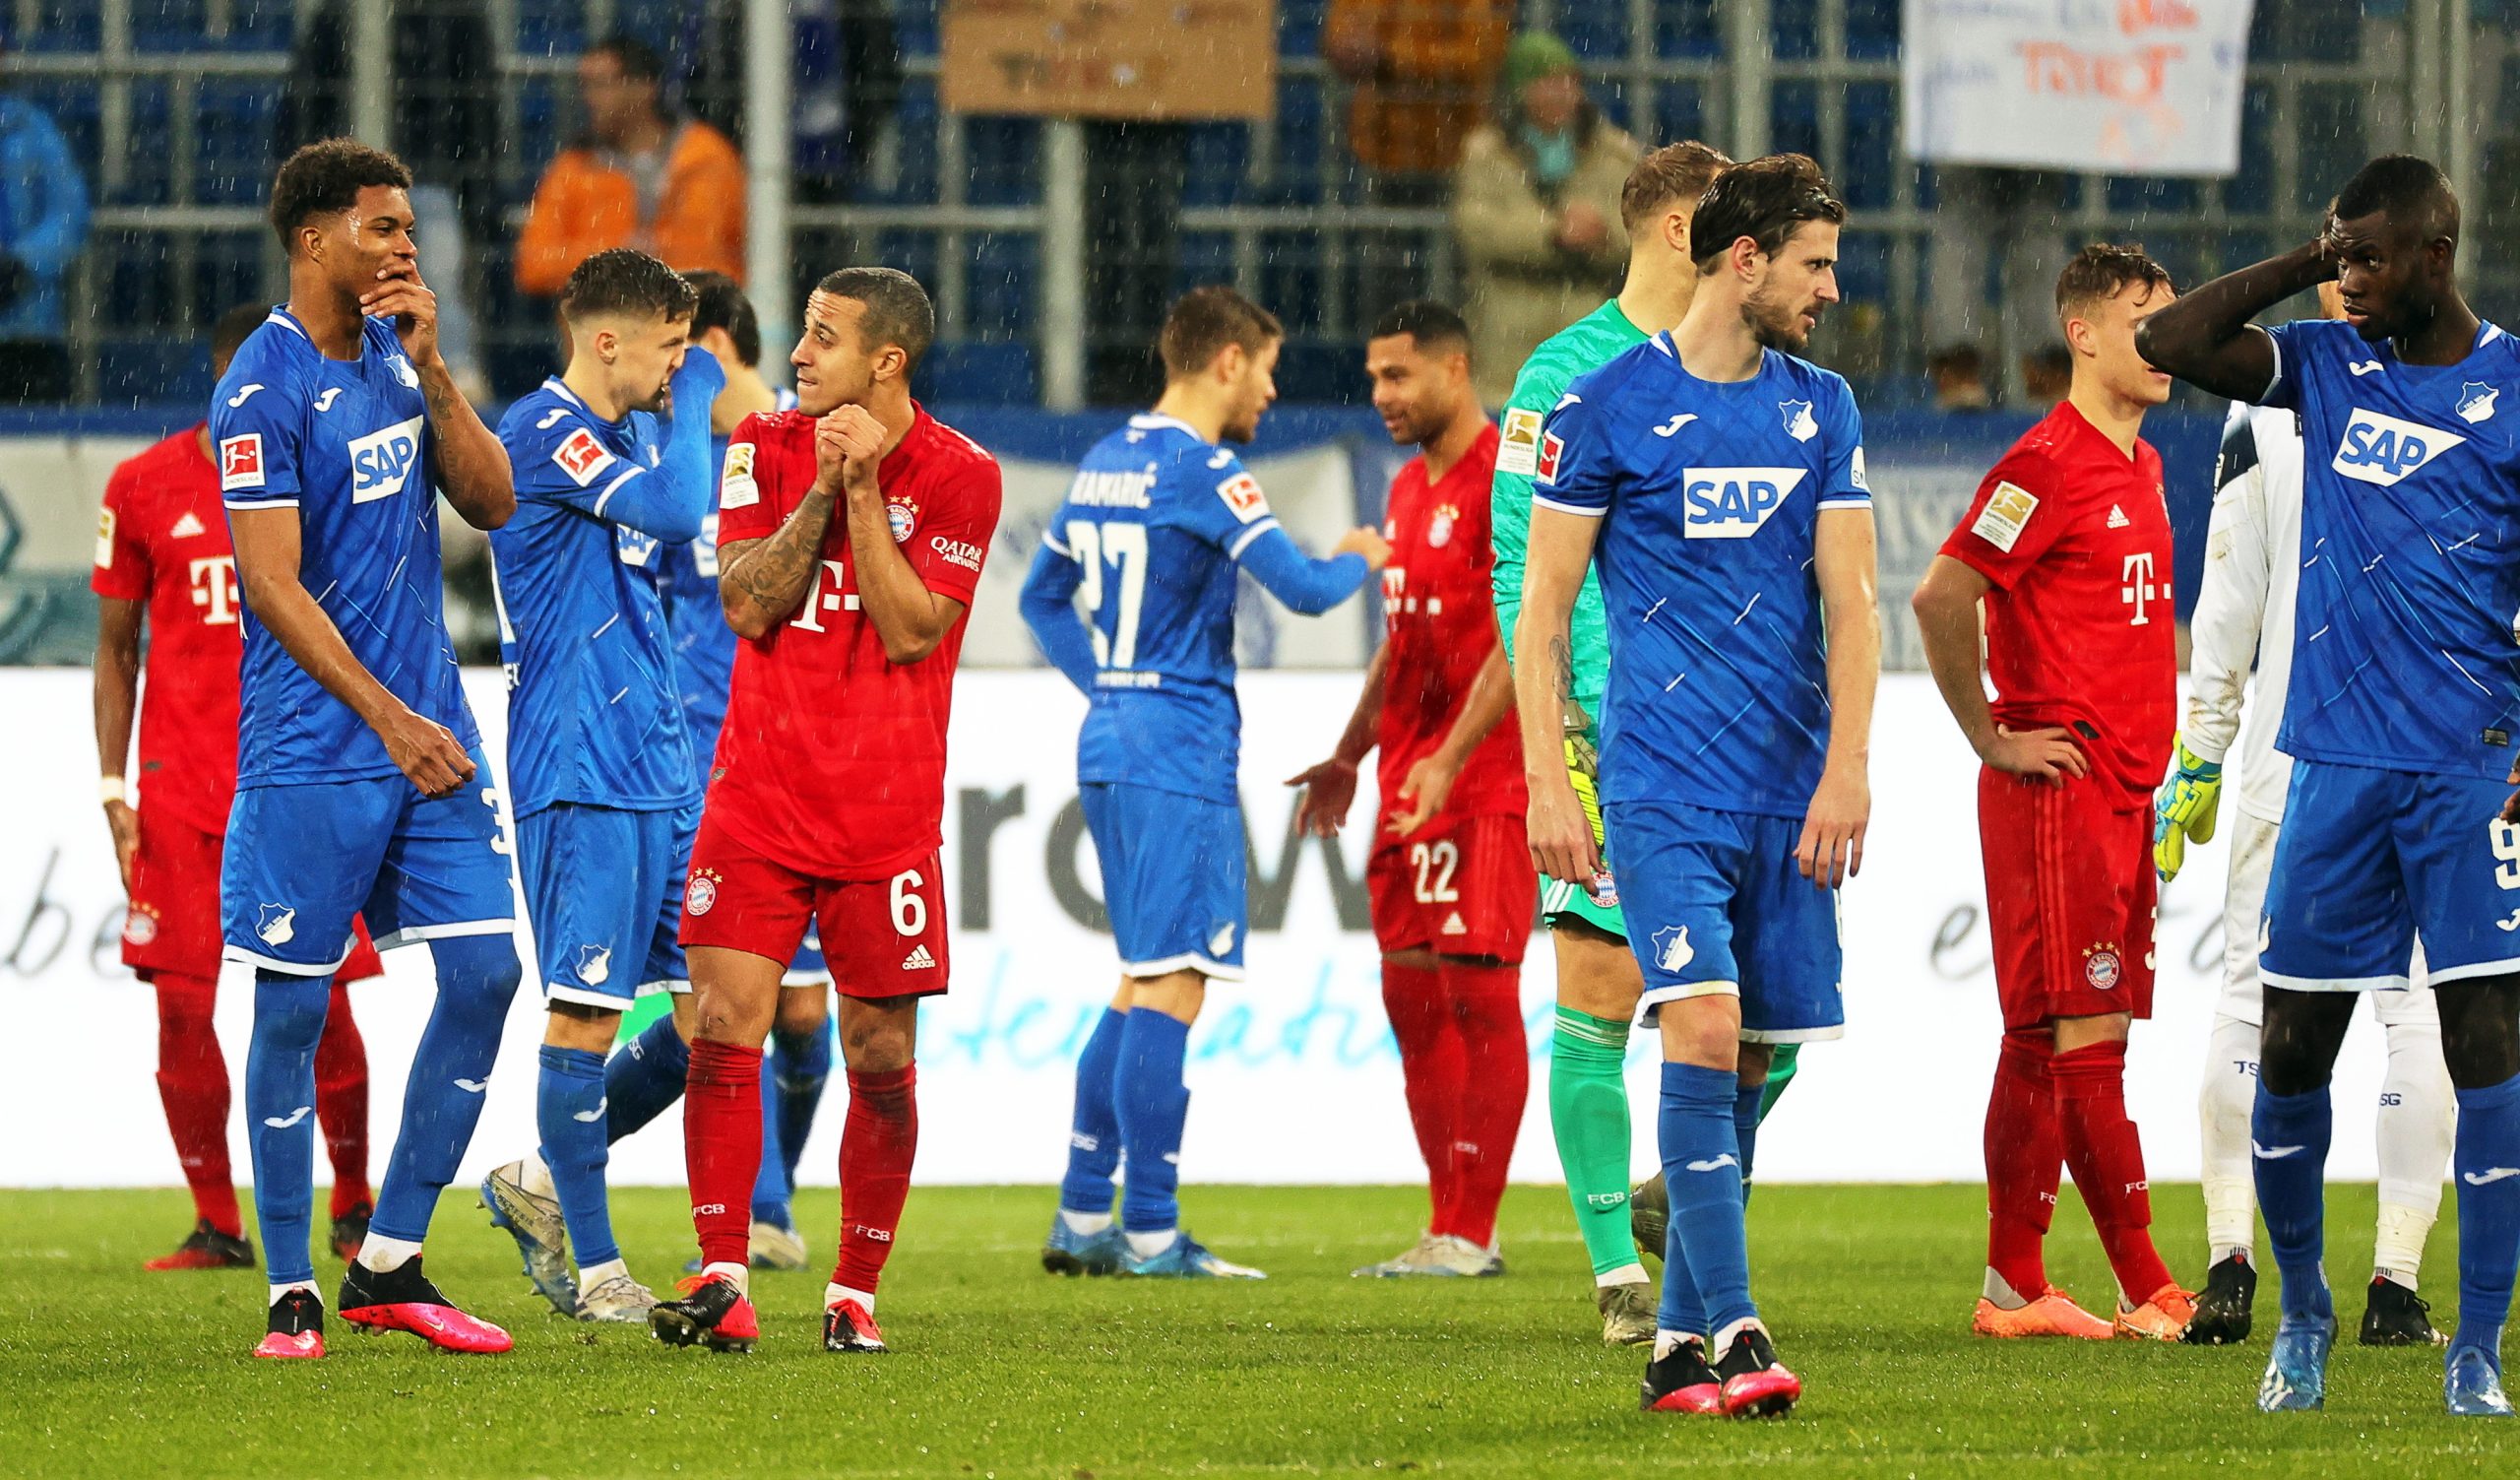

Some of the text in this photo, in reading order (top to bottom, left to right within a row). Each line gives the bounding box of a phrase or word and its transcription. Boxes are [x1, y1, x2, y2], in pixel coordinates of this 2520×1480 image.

[355, 436, 412, 489] SAP
[2340, 422, 2427, 476] SAP
[1687, 482, 1778, 524] SAP
[930, 536, 982, 562] QATAR
[1066, 520, 1147, 669] 27
[1410, 840, 1460, 903] 22
[889, 869, 926, 936] 6
[902, 959, 935, 970] adidas
[693, 1203, 725, 1218] FCB
[1587, 1191, 1625, 1205] FCB
[855, 1224, 891, 1242] FCB
